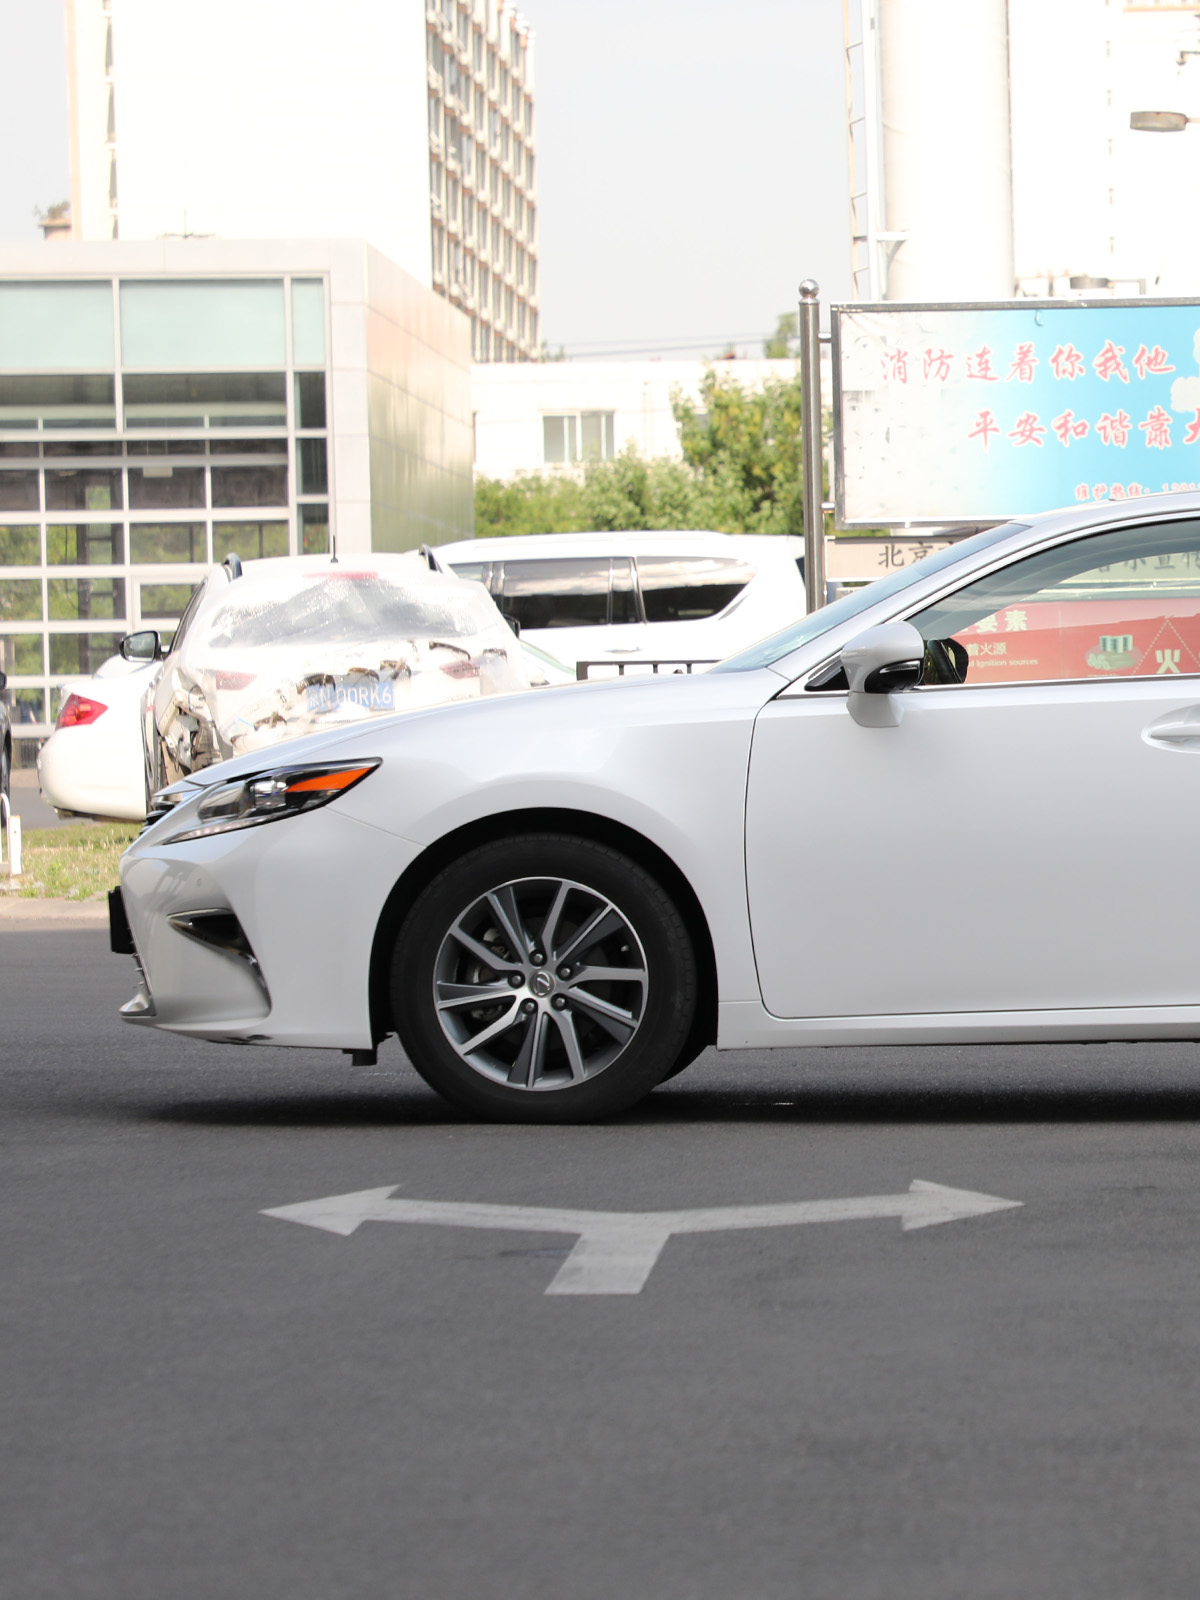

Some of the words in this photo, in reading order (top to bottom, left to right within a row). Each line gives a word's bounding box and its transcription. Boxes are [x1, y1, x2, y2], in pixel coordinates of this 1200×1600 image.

[880, 341, 1177, 384] 消防连着你我他
[1155, 649, 1181, 675] 火
